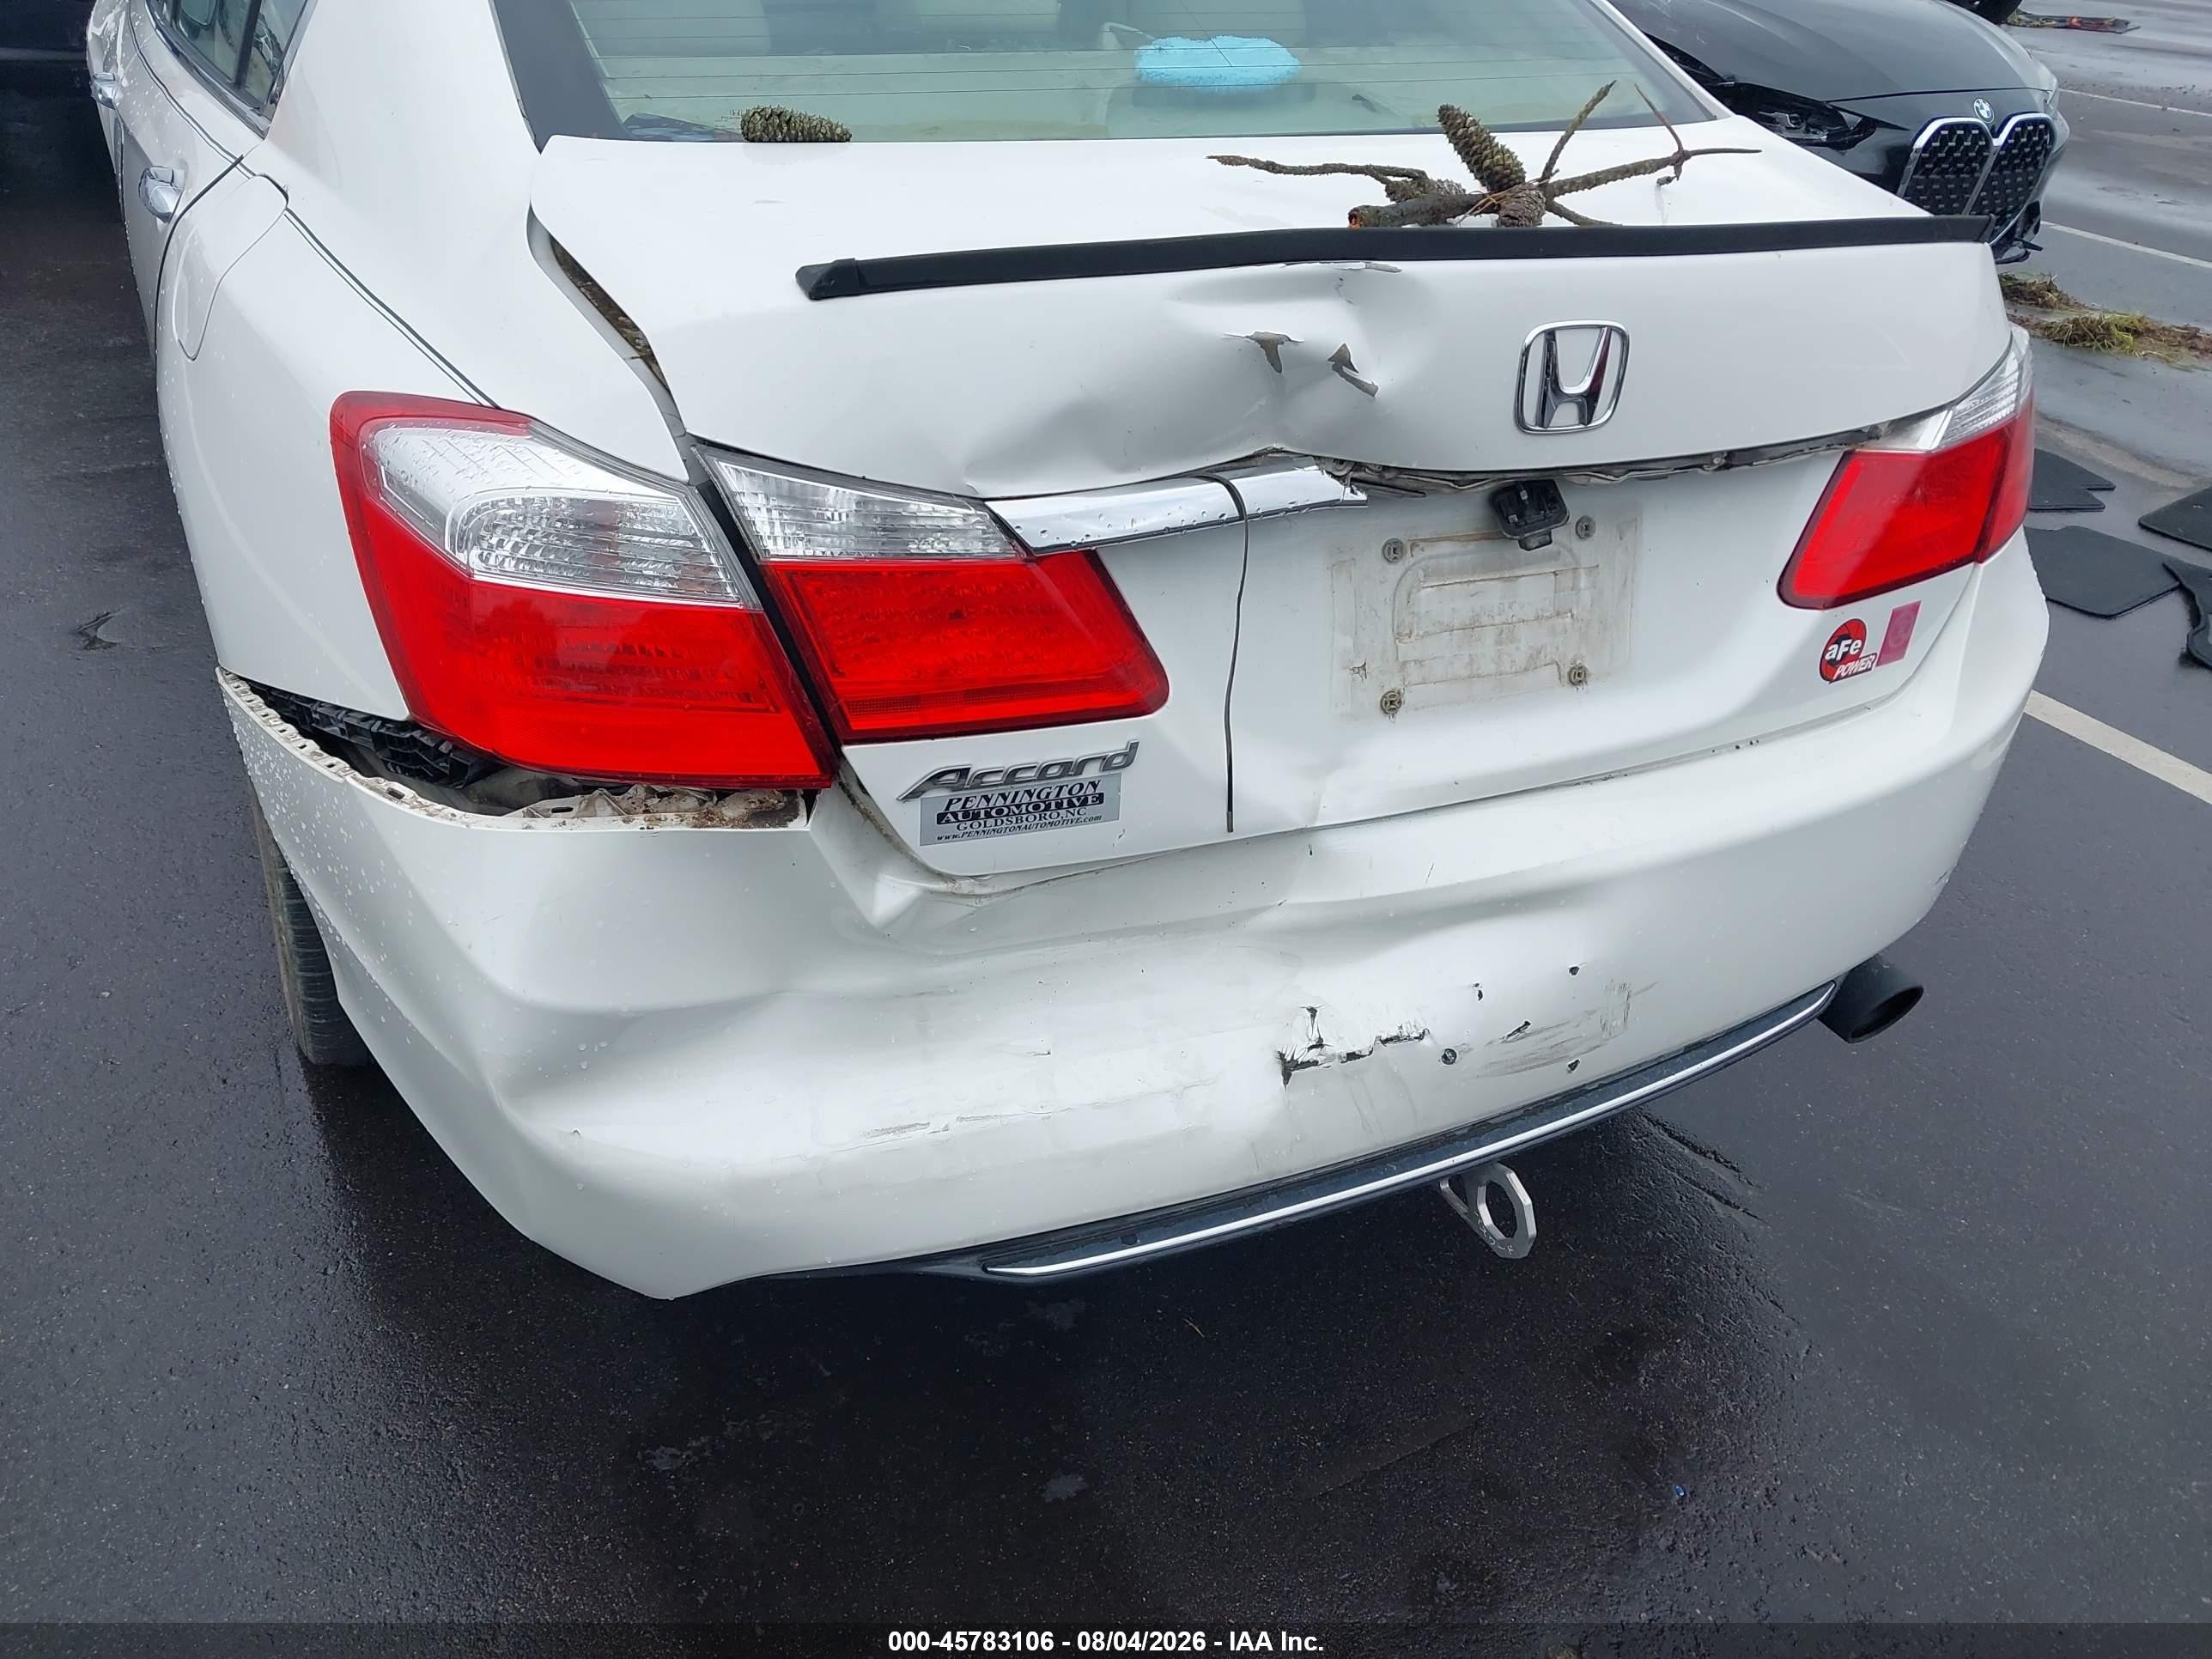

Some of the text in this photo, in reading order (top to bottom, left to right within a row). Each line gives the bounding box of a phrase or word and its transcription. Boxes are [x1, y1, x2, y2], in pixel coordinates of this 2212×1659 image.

[1825, 638, 1863, 661] aFe
[1833, 654, 1876, 680] POWER
[896, 738, 1140, 803] Accord
[940, 793, 1101, 823] AUTOMOTIVE
[943, 779, 1102, 811] PENNINGTON
[936, 815, 1103, 842] www.PENNINGTONAUTOMOTIVE.com
